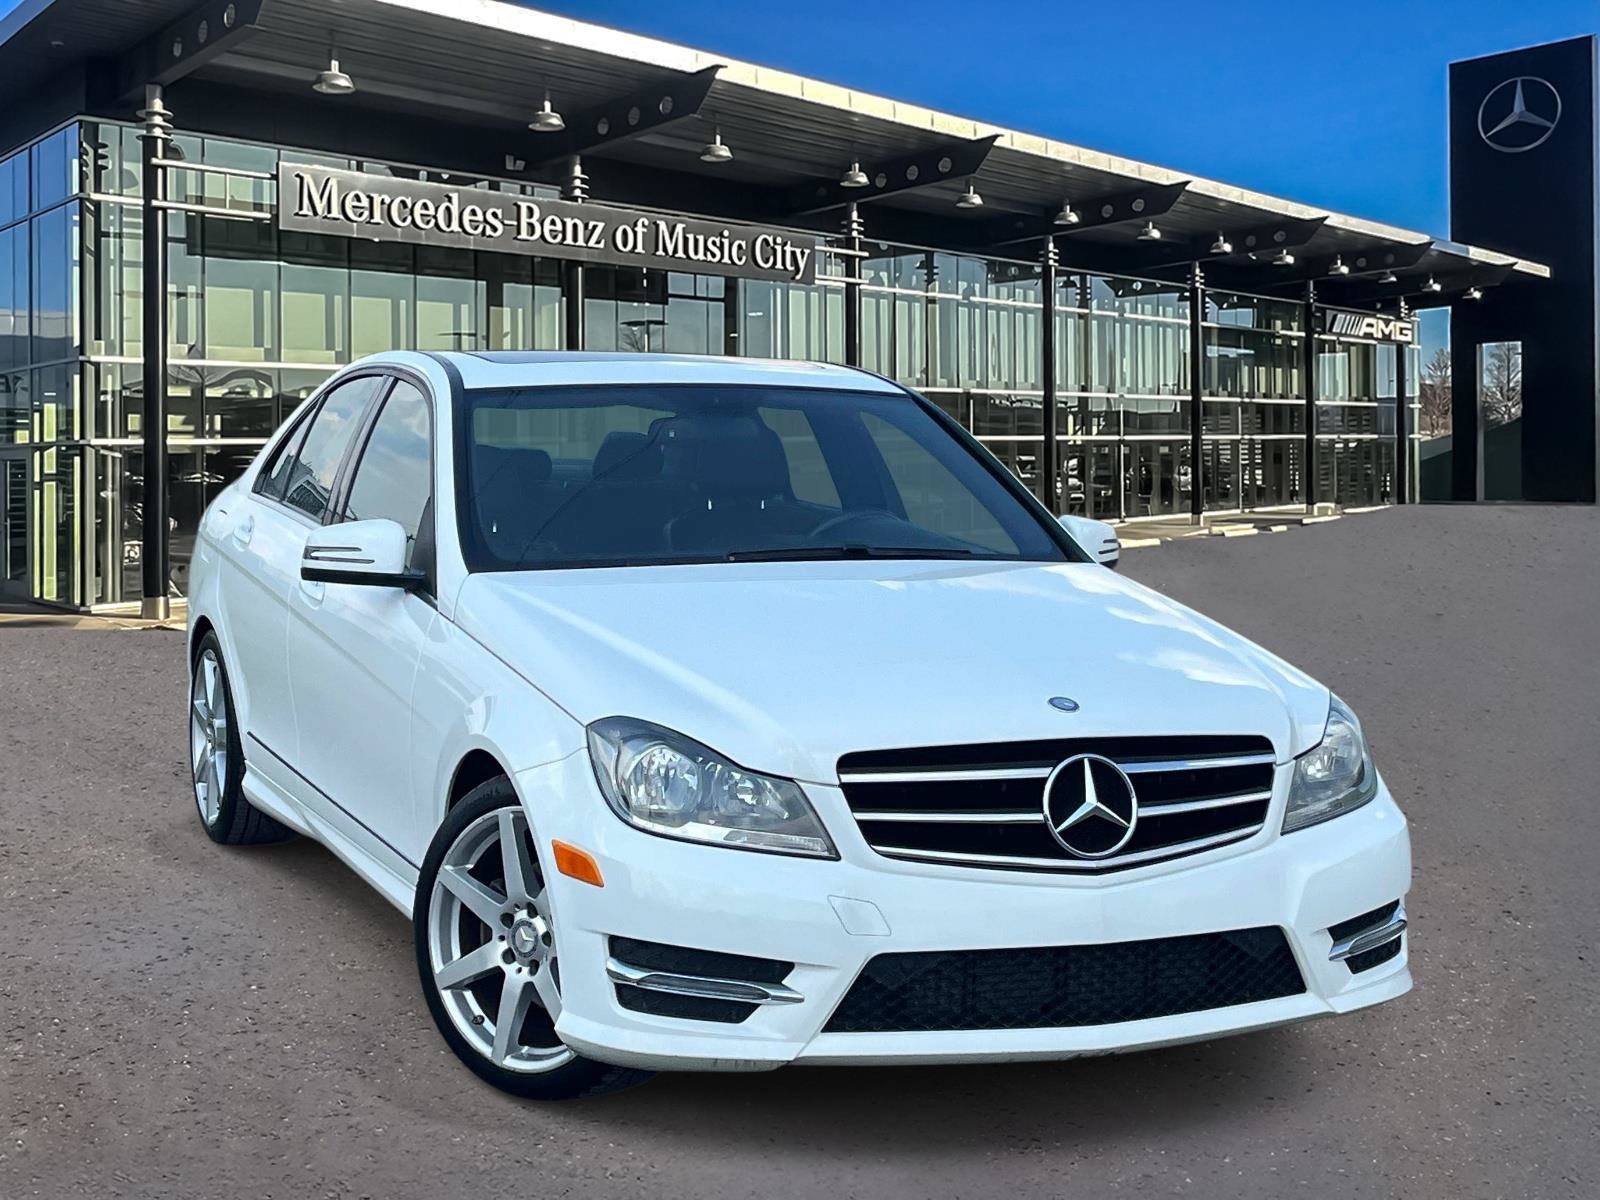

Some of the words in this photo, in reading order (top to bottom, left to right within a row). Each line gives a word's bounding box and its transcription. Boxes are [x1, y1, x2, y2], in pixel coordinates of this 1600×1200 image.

[293, 172, 605, 249] Mercedes-Benz
[614, 217, 649, 253] of
[655, 220, 747, 266] Music
[754, 233, 811, 280] City
[1358, 317, 1412, 342] AMG
